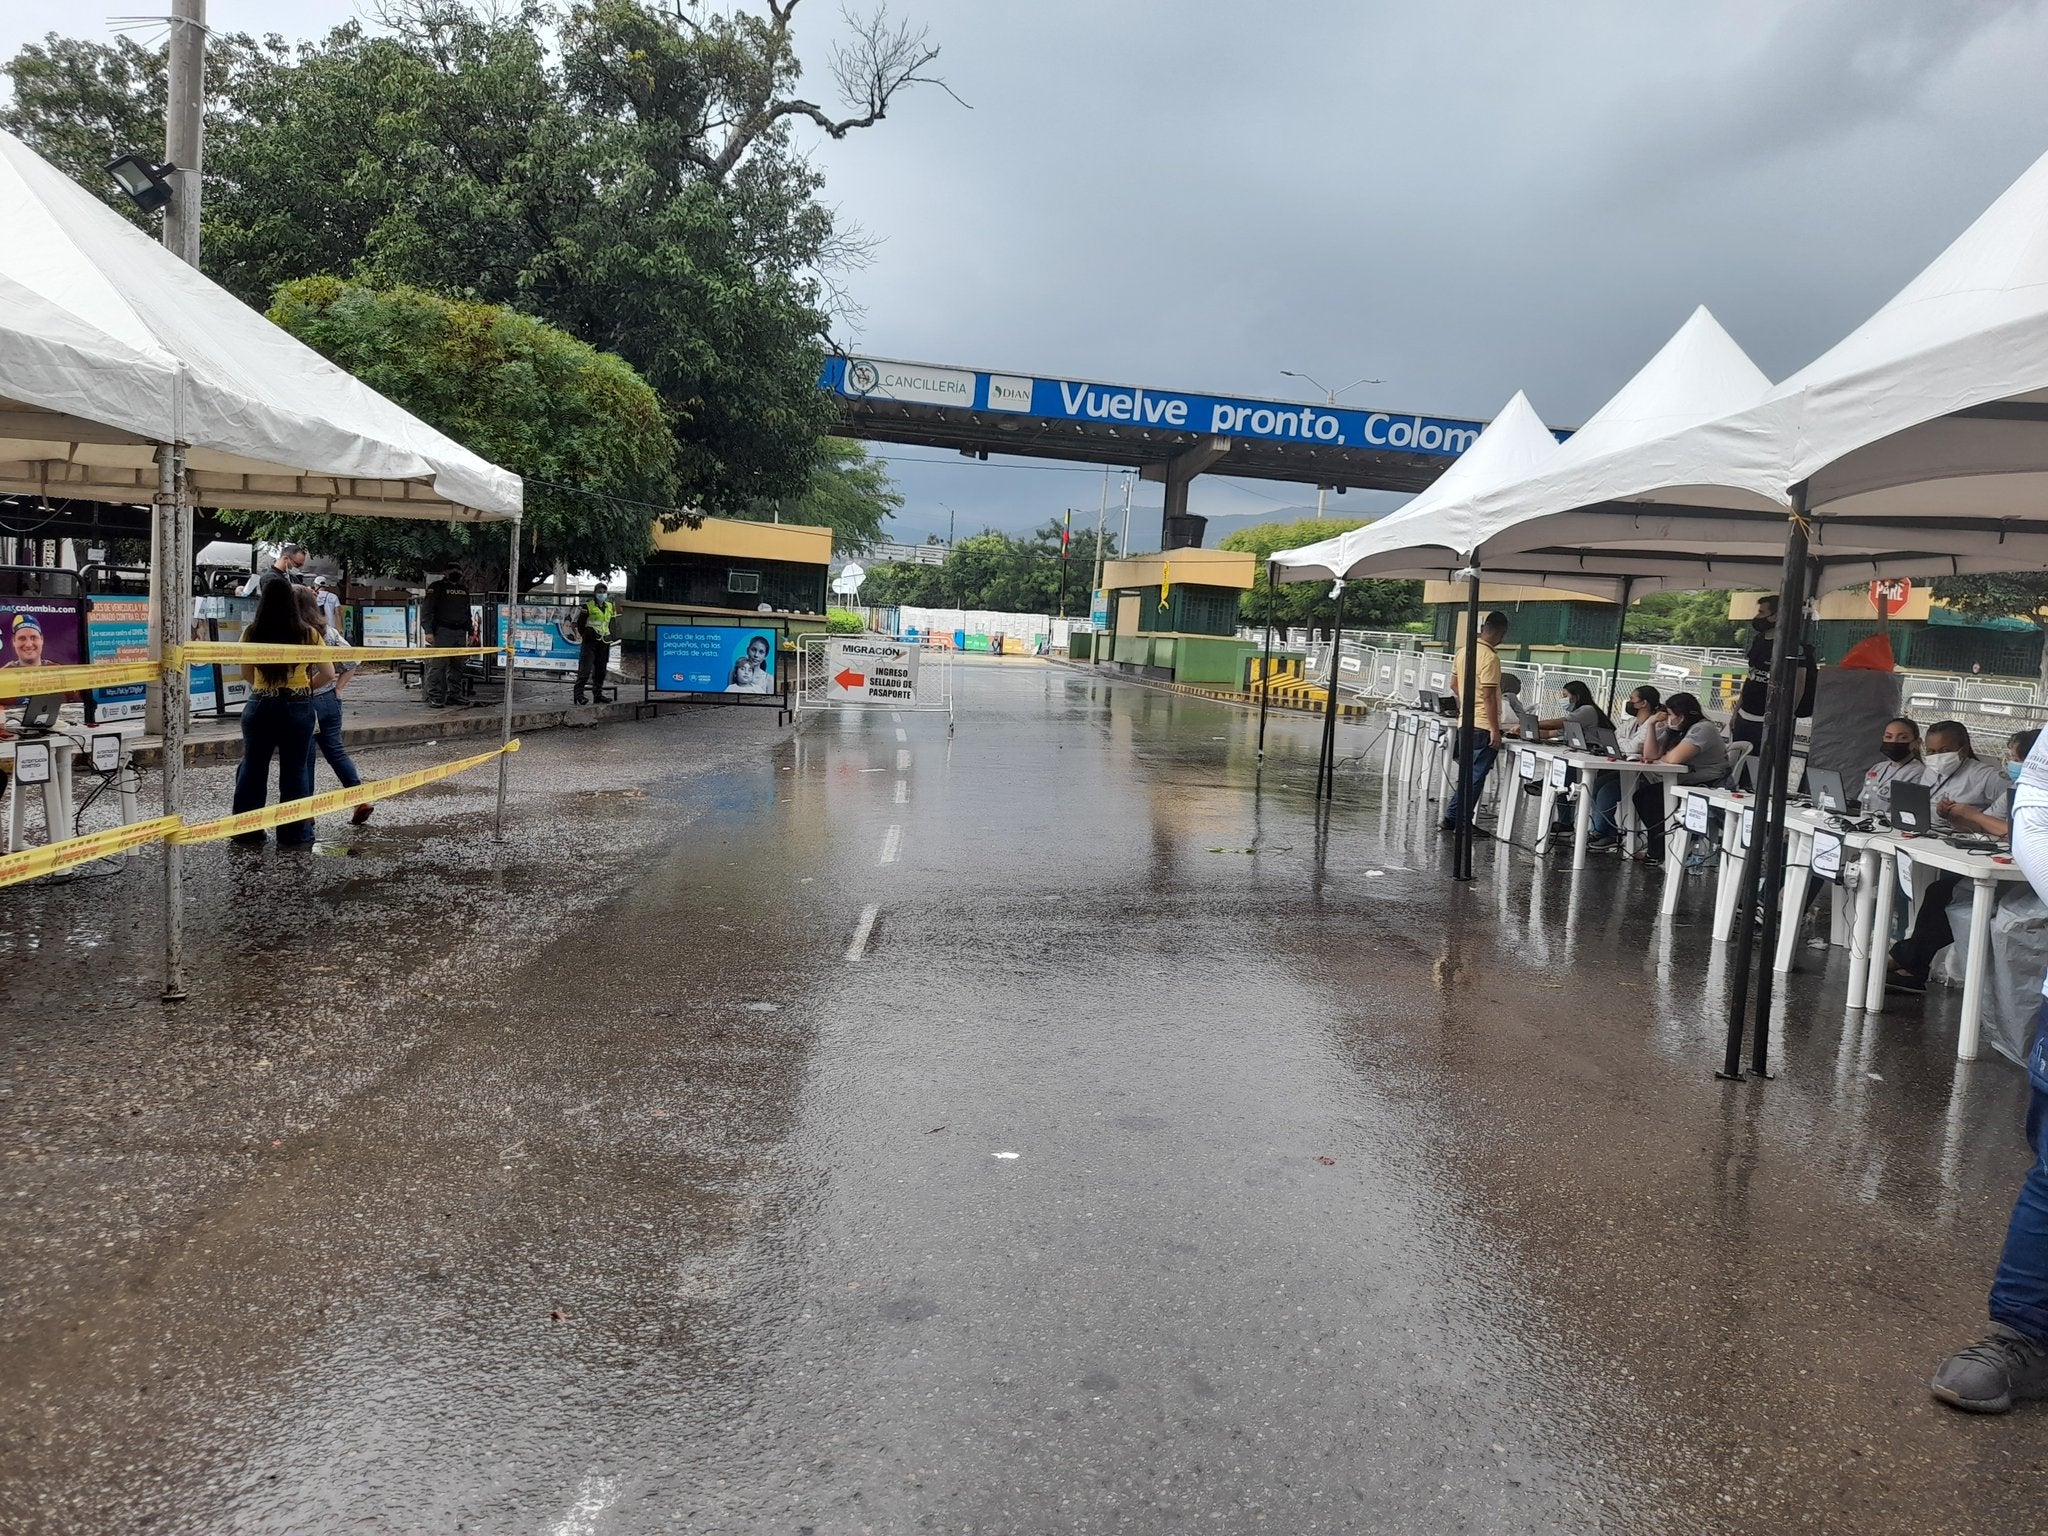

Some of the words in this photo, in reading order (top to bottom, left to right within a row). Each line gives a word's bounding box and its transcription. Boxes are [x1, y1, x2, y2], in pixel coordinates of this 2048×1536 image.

[885, 374, 967, 395] CANCILLERÍA
[1002, 388, 1030, 400] DIAN
[1058, 381, 1189, 425] Vuelve
[1211, 403, 1346, 445] pronto,
[1364, 413, 1487, 453] Colom
[663, 632, 683, 640] Cuida
[663, 641, 699, 649] pequeños,
[842, 644, 900, 656] MIGRACIÓN
[690, 649, 700, 657] de
[875, 667, 908, 678] INGRESO
[869, 677, 901, 688] SELLADO
[902, 680, 914, 689] DE
[868, 688, 911, 699] PASAPORTE
